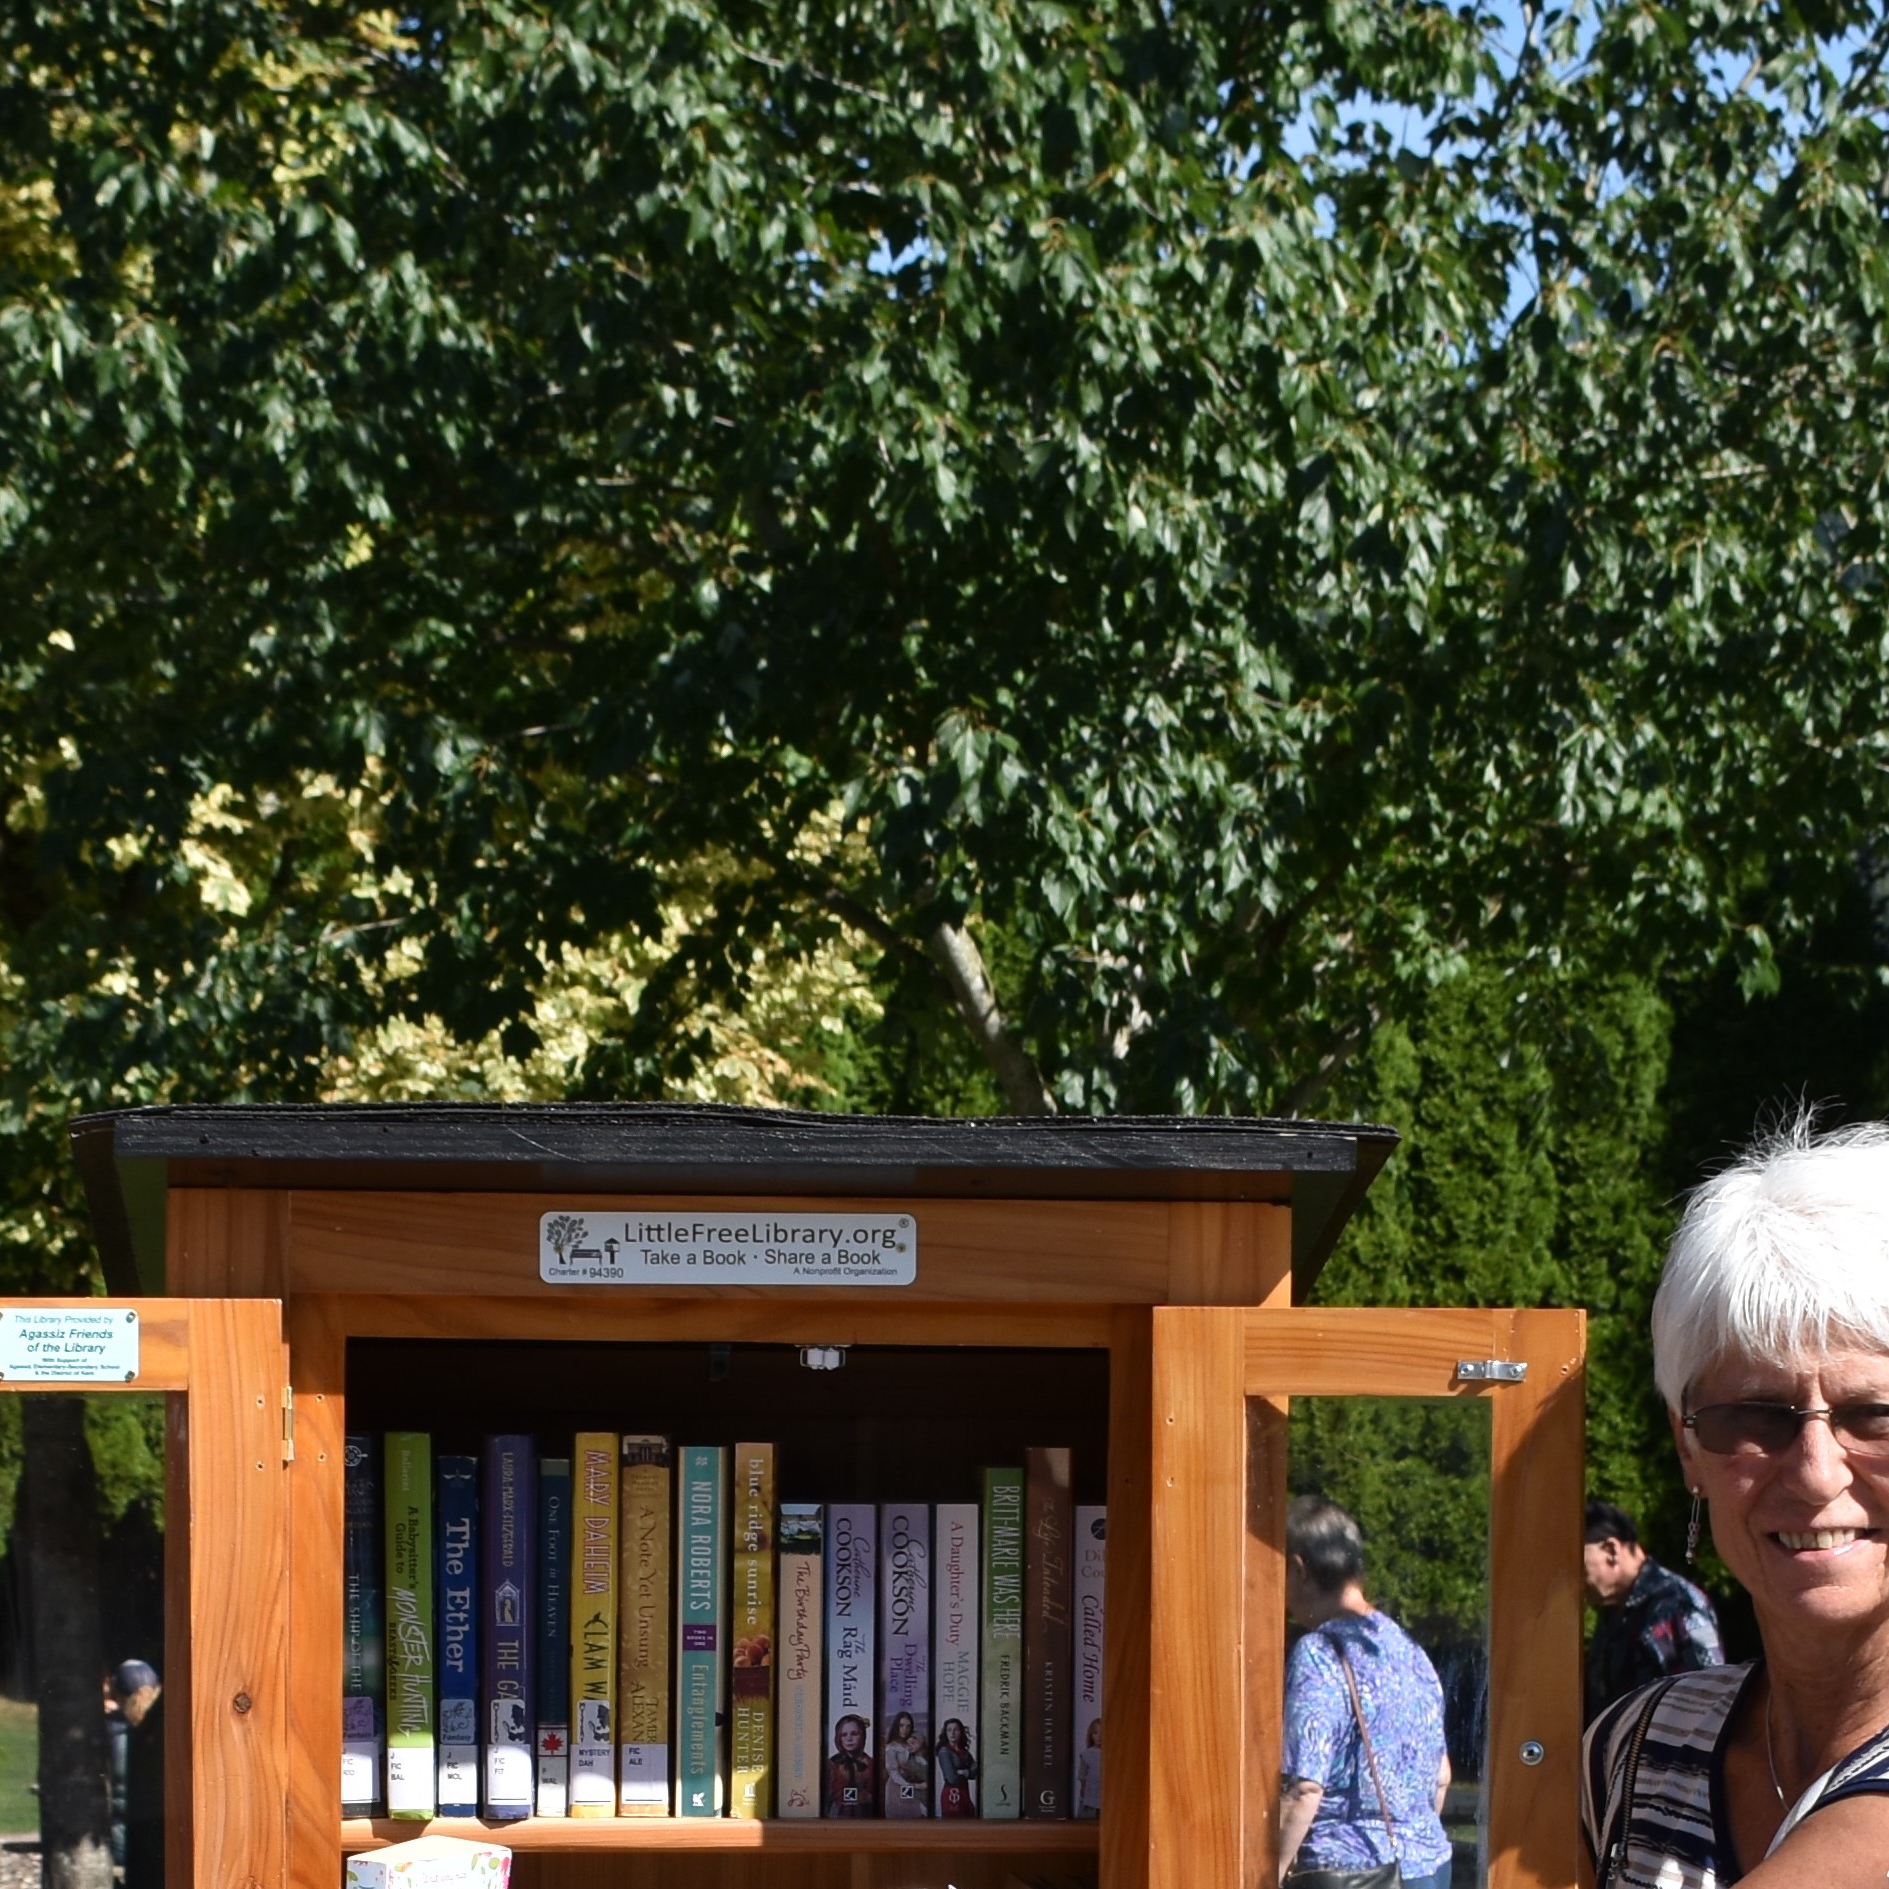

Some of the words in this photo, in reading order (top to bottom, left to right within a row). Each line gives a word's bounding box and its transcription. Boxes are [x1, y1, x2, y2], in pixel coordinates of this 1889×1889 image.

[624, 1221, 897, 1249] LittleFreeLibrary.org
[640, 1249, 681, 1265] Take
[686, 1253, 697, 1265] a
[703, 1249, 746, 1265] Book
[765, 1249, 815, 1265] Share
[821, 1253, 831, 1265] a
[838, 1249, 881, 1265] Book
[548, 1267, 580, 1276] Charter
[589, 1268, 624, 1279] 94390
[793, 1267, 801, 1275] A
[803, 1267, 841, 1276] Nonprofit
[844, 1267, 898, 1277] Organization
[14, 1315, 31, 1324] This
[34, 1315, 62, 1325] Library
[65, 1315, 102, 1324] Provided
[103, 1316, 114, 1325] by
[19, 1329, 66, 1341] Agassiz
[69, 1329, 114, 1339] Friends
[27, 1342, 40, 1352] of
[42, 1343, 60, 1352] the
[64, 1343, 106, 1355] Library
[584, 1450, 611, 1506] MARY
[748, 1458, 764, 1498] blue
[408, 1505, 418, 1515] A
[548, 1496, 559, 1523] ONE
[640, 1506, 654, 1518] A
[690, 1481, 712, 1526] NORA
[395, 1523, 406, 1559] Guide
[446, 1517, 470, 1575] The
[548, 1529, 559, 1561] FOOT
[639, 1525, 657, 1567] Note
[743, 1504, 763, 1552] ridge
[950, 1521, 964, 1532] A
[992, 1486, 1020, 1568] BRITT-MARIE
[395, 1564, 403, 1574] to
[408, 1519, 419, 1590] Babysitter's
[583, 1517, 611, 1595] DAHEIM
[690, 1535, 712, 1611] ROBERTS
[796, 1560, 811, 1584] The
[835, 1517, 853, 1617] COOKSON
[891, 1515, 909, 1637] COOKSON
[946, 1536, 964, 1609] Daughter's
[349, 1573, 360, 1599] THE
[639, 1572, 656, 1598] Yet
[747, 1559, 762, 1625] sunrise
[993, 1573, 1020, 1604] WAS
[1041, 1552, 1065, 1632] Intended
[349, 1606, 361, 1635] SHIP
[386, 1586, 430, 1671] MONSTER
[446, 1586, 470, 1673] Ether
[547, 1584, 559, 1637] HEAVEN
[788, 1584, 810, 1647] Birthday
[947, 1613, 963, 1646] Duty
[993, 1608, 1021, 1639] HERE
[1081, 1594, 1102, 1651] Called
[497, 1640, 519, 1670] THE
[583, 1612, 609, 1670] CLAM
[633, 1605, 656, 1668] Unsung
[837, 1626, 858, 1659] Rag
[854, 1634, 866, 1654] The
[350, 1665, 362, 1691] THE
[786, 1644, 811, 1680] Party
[890, 1657, 903, 1693] Place
[899, 1643, 918, 1707] Dwelling
[943, 1661, 955, 1702] HOPE
[957, 1651, 970, 1713] MAGGIE
[1000, 1654, 1010, 1698] FREDRIK
[1082, 1653, 1099, 1703] Home
[396, 1673, 432, 1739] HUNTING
[842, 1664, 858, 1708] Maid
[1044, 1661, 1054, 1712] KRISTIN
[686, 1665, 709, 1775] Entanglements
[736, 1707, 750, 1774] HUNTER
[1000, 1703, 1010, 1756] BACKMAN
[1044, 1717, 1054, 1767] HARMEL
[752, 1712, 765, 1773] DENISE
